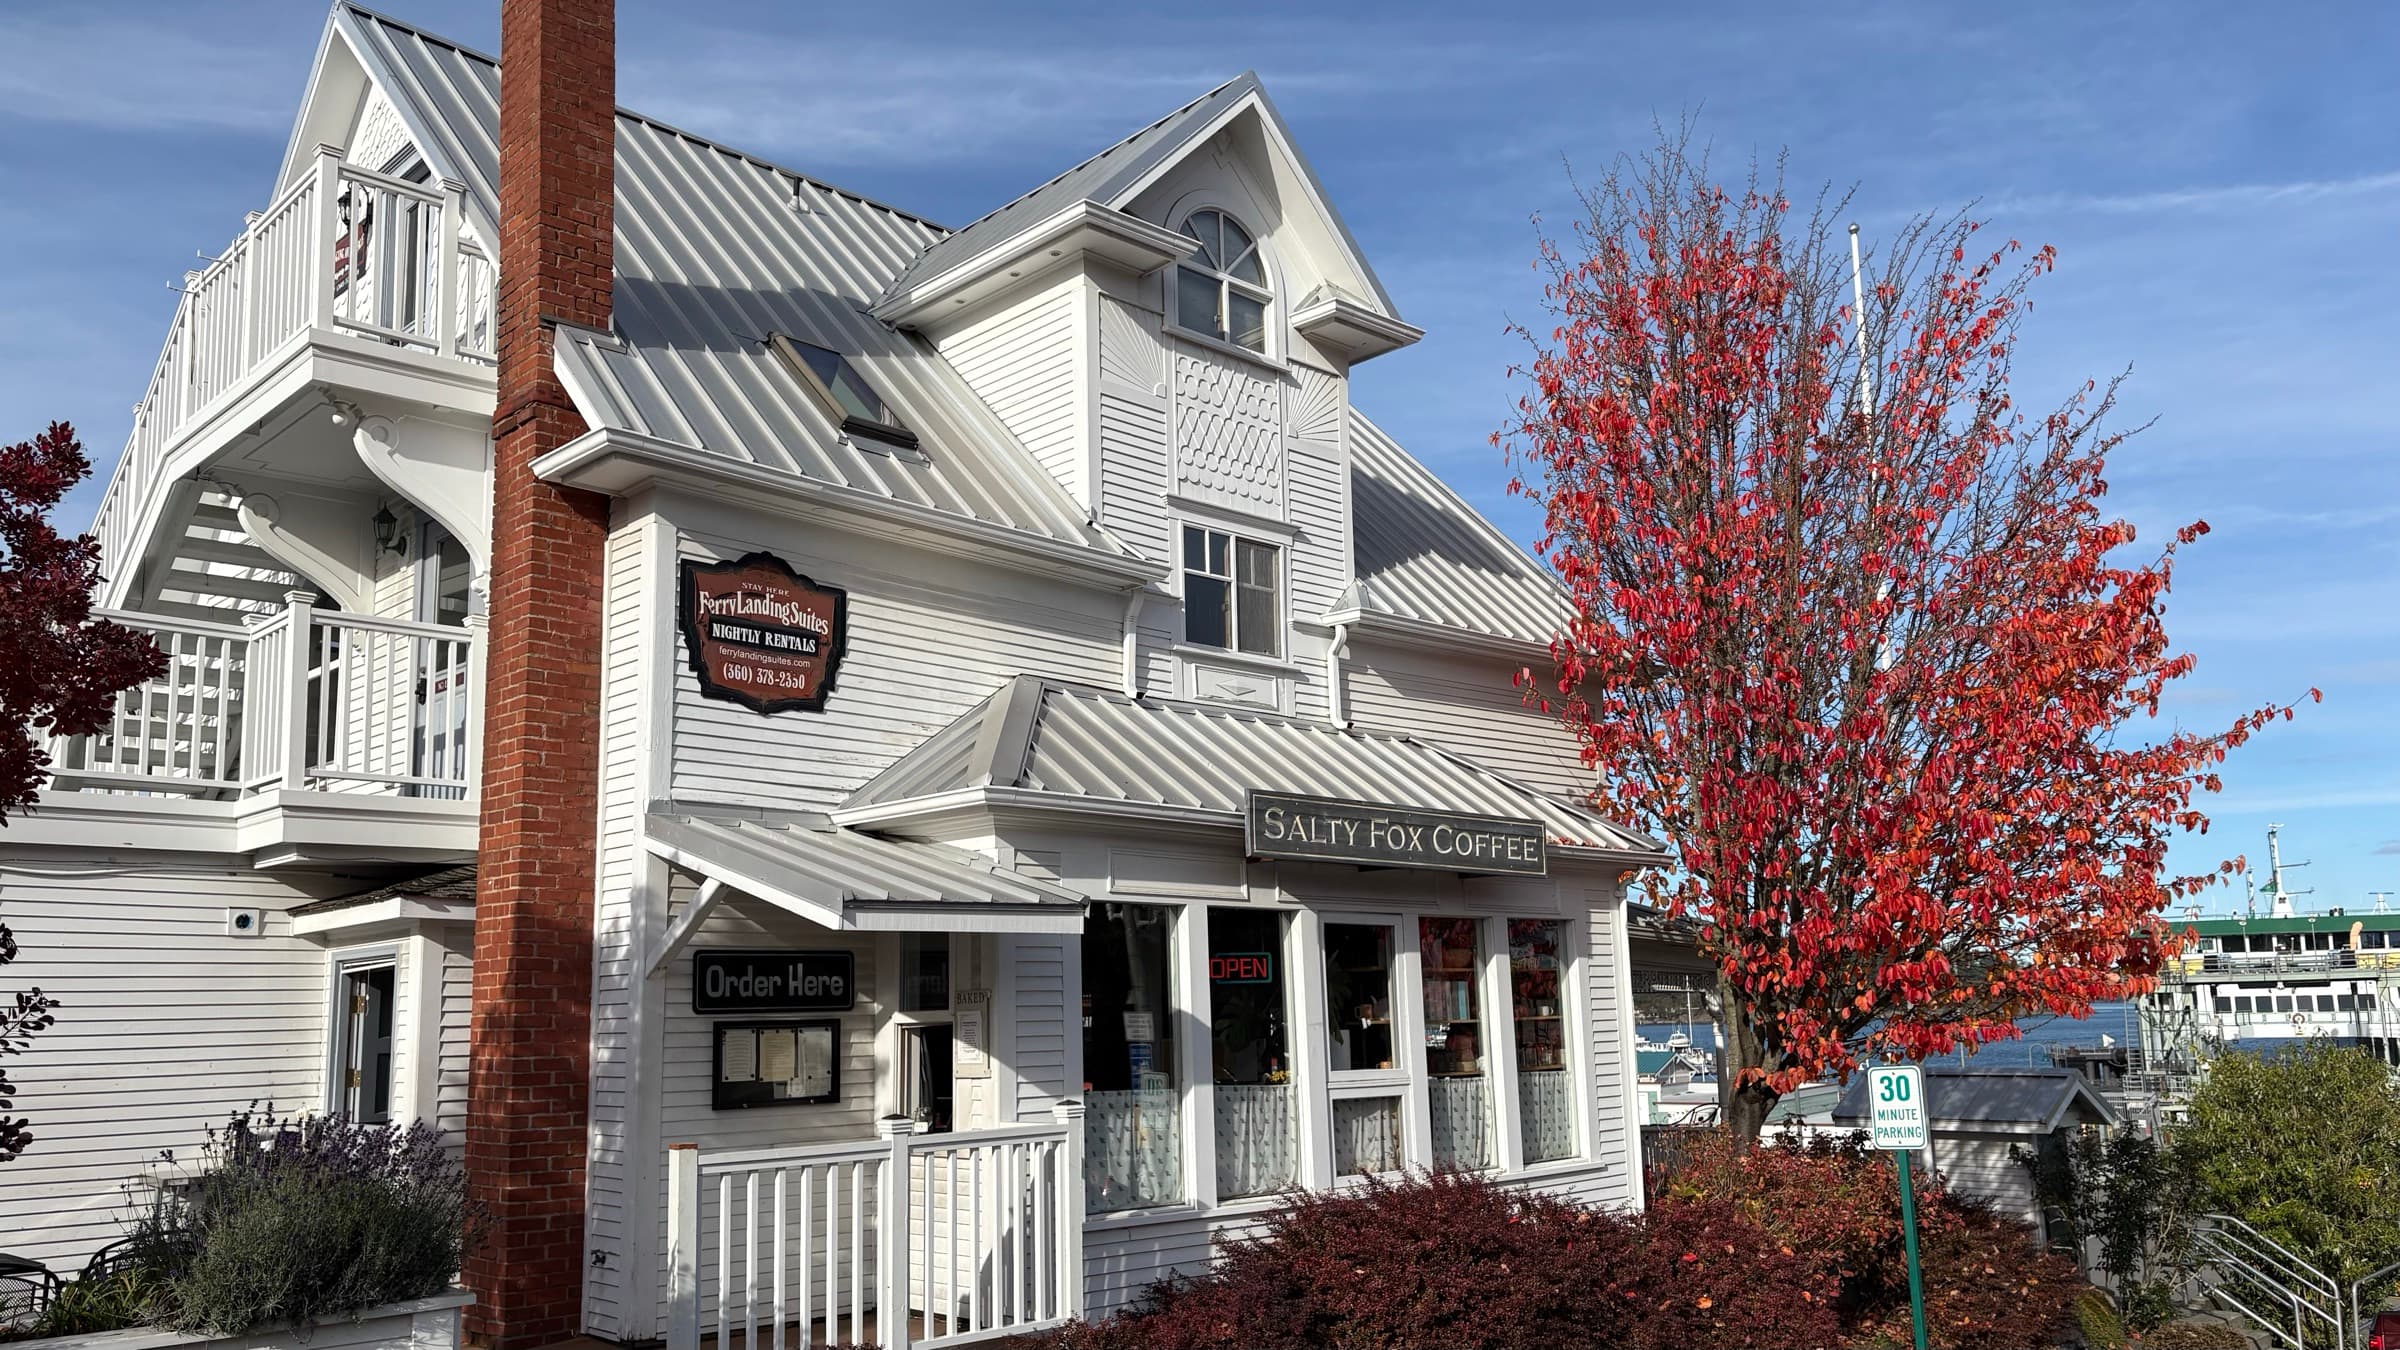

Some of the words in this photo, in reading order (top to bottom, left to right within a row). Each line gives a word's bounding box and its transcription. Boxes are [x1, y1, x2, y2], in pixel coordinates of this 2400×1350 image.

[742, 582, 763, 591] STAY
[766, 587, 790, 597] HERE
[712, 623, 761, 644] NIGHTLY
[765, 631, 816, 653] RENTALS
[719, 646, 811, 668] ferrylandingsuites.com
[723, 662, 753, 684] (360)
[1263, 806, 1361, 847] SALTY
[1369, 816, 1424, 852] FOX
[1432, 823, 1539, 862] COFFEE
[1209, 957, 1267, 978] OPEN
[705, 964, 782, 998] Order
[788, 963, 844, 997] Here
[1880, 1075, 1910, 1101] 30
[1878, 1109, 1918, 1120] MINUTE
[1878, 1127, 1921, 1138] PARKING
